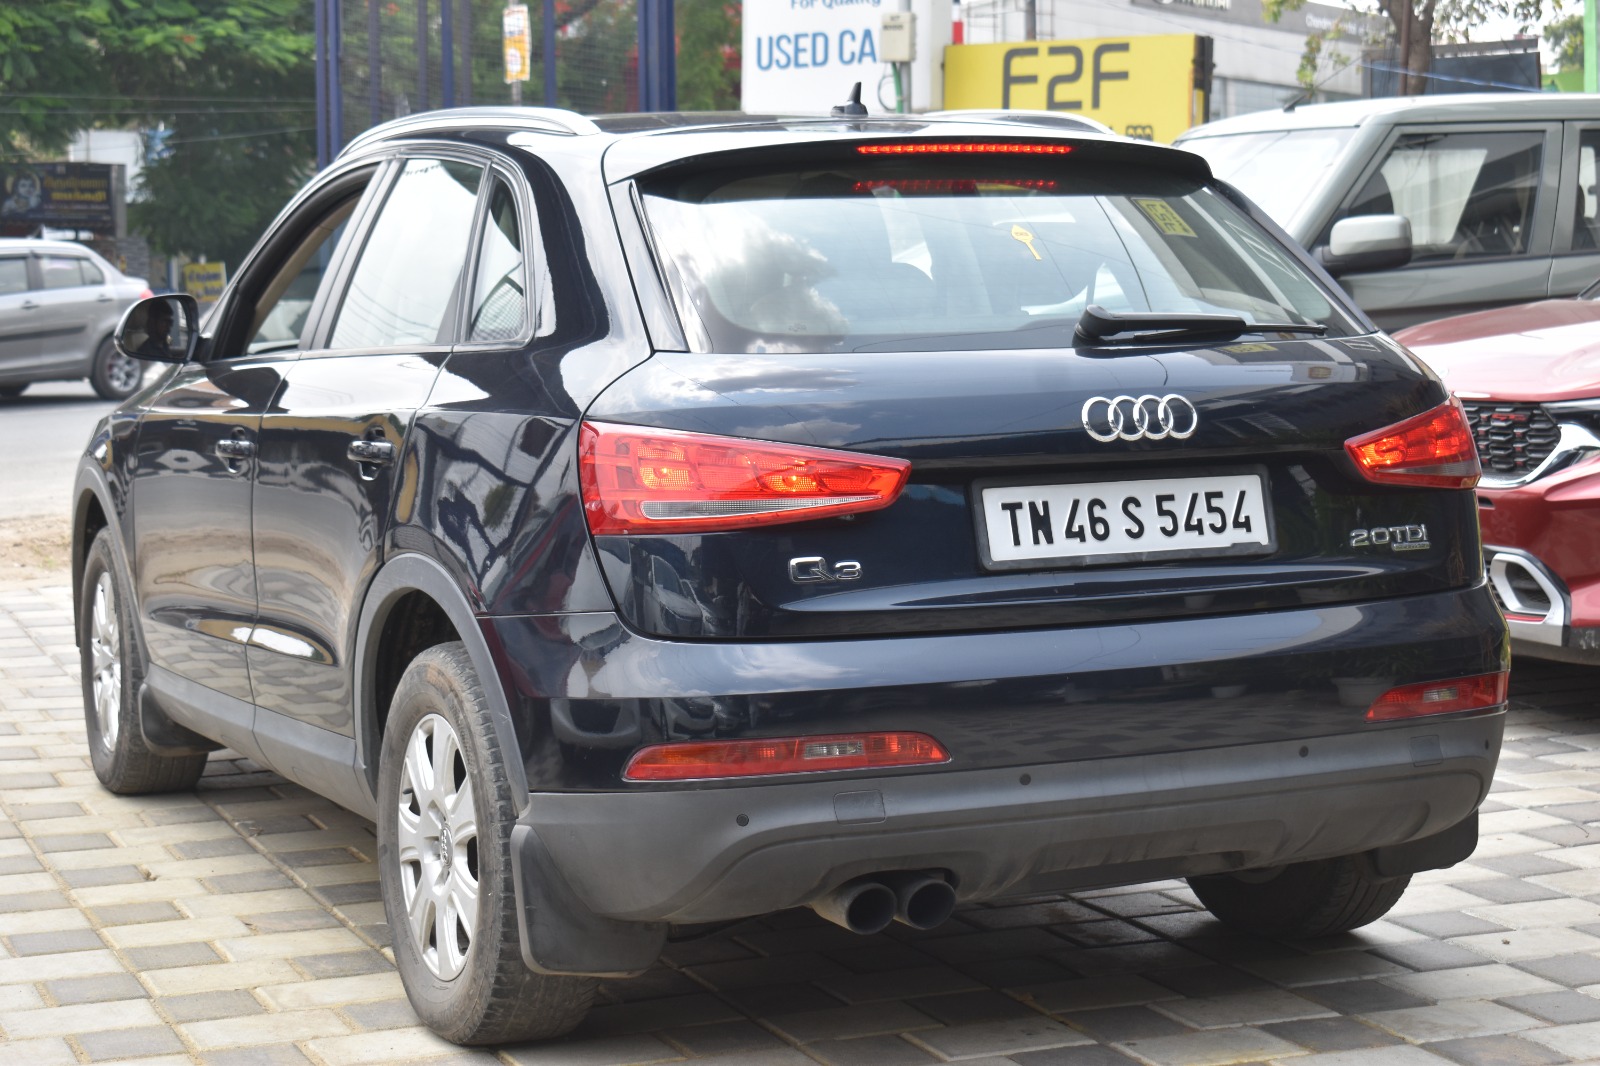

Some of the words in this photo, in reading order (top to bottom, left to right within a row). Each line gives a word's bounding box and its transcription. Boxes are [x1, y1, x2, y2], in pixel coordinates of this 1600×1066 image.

[757, 31, 829, 71] USED
[1001, 43, 1131, 110] F2F
[1001, 500, 1054, 546] TN
[1065, 498, 1110, 543] 46
[1121, 496, 1145, 539] S
[1155, 490, 1252, 537] 5454
[788, 556, 862, 583] Q3
